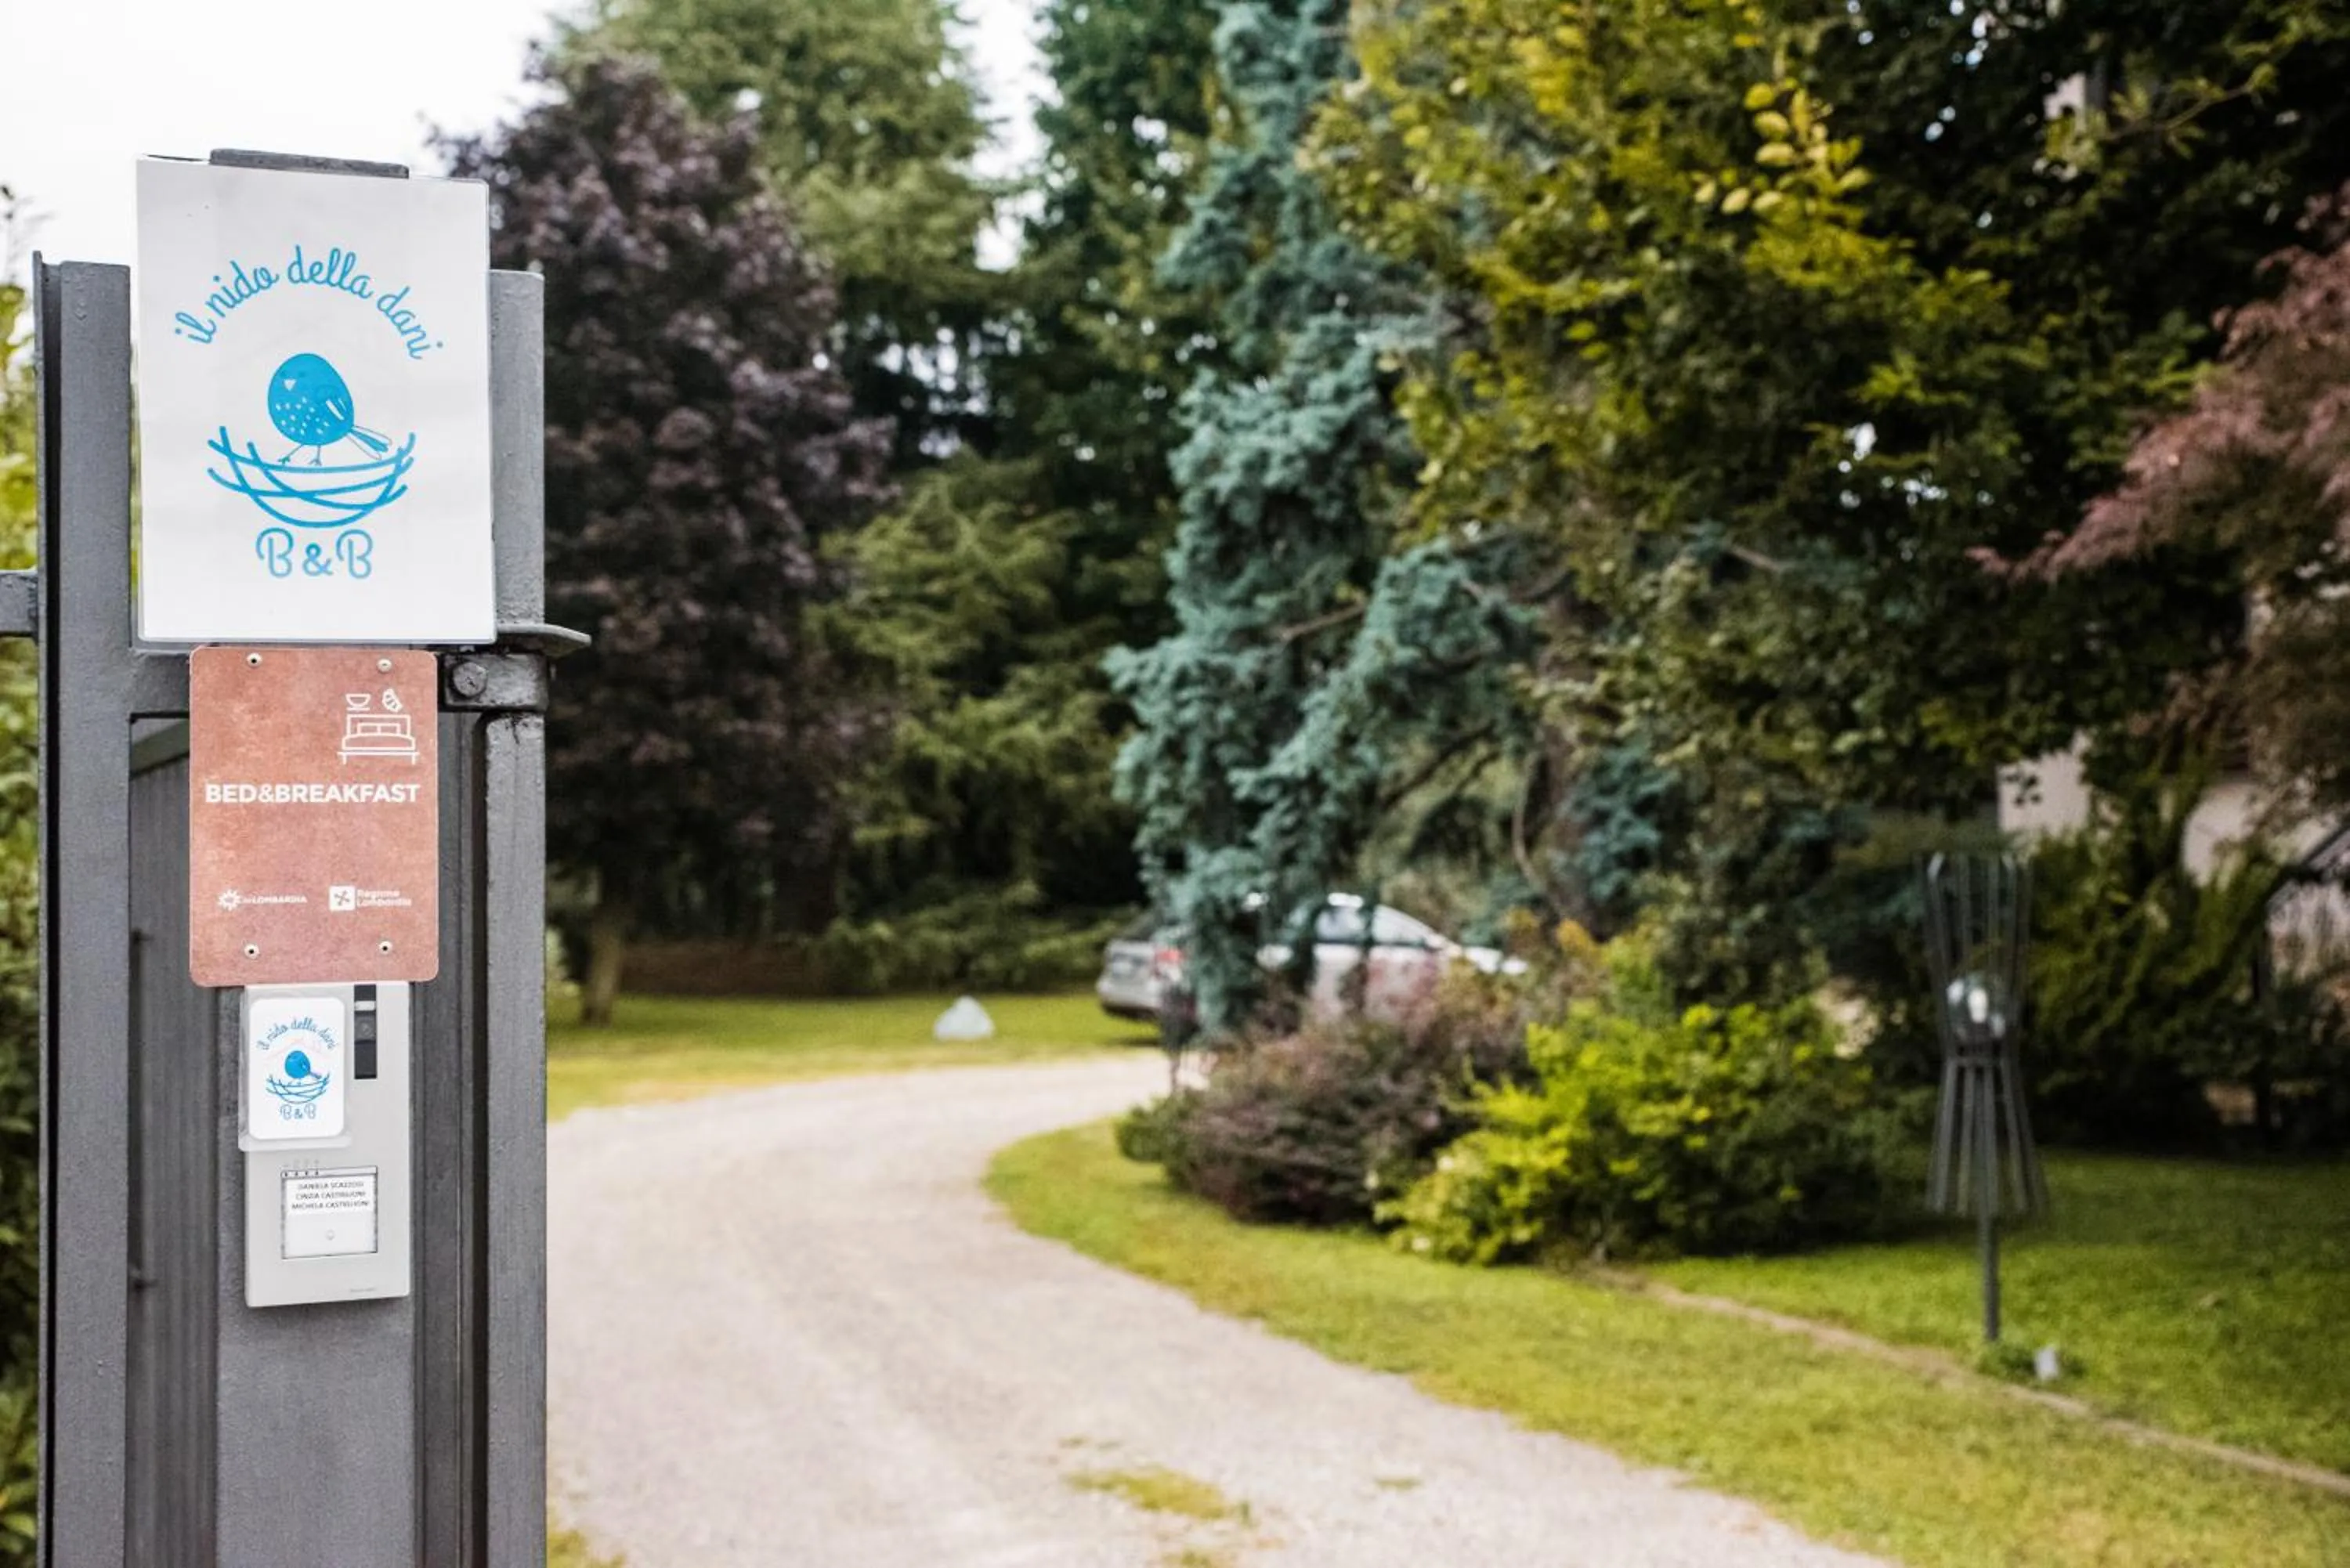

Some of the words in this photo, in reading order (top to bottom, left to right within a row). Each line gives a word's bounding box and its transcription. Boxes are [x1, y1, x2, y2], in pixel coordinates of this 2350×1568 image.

[175, 311, 218, 345] il
[205, 260, 280, 318] nido
[287, 244, 375, 300] della
[376, 286, 444, 360] dani
[205, 783, 421, 804] BED&BREAKFAST
[291, 1017, 316, 1033] della
